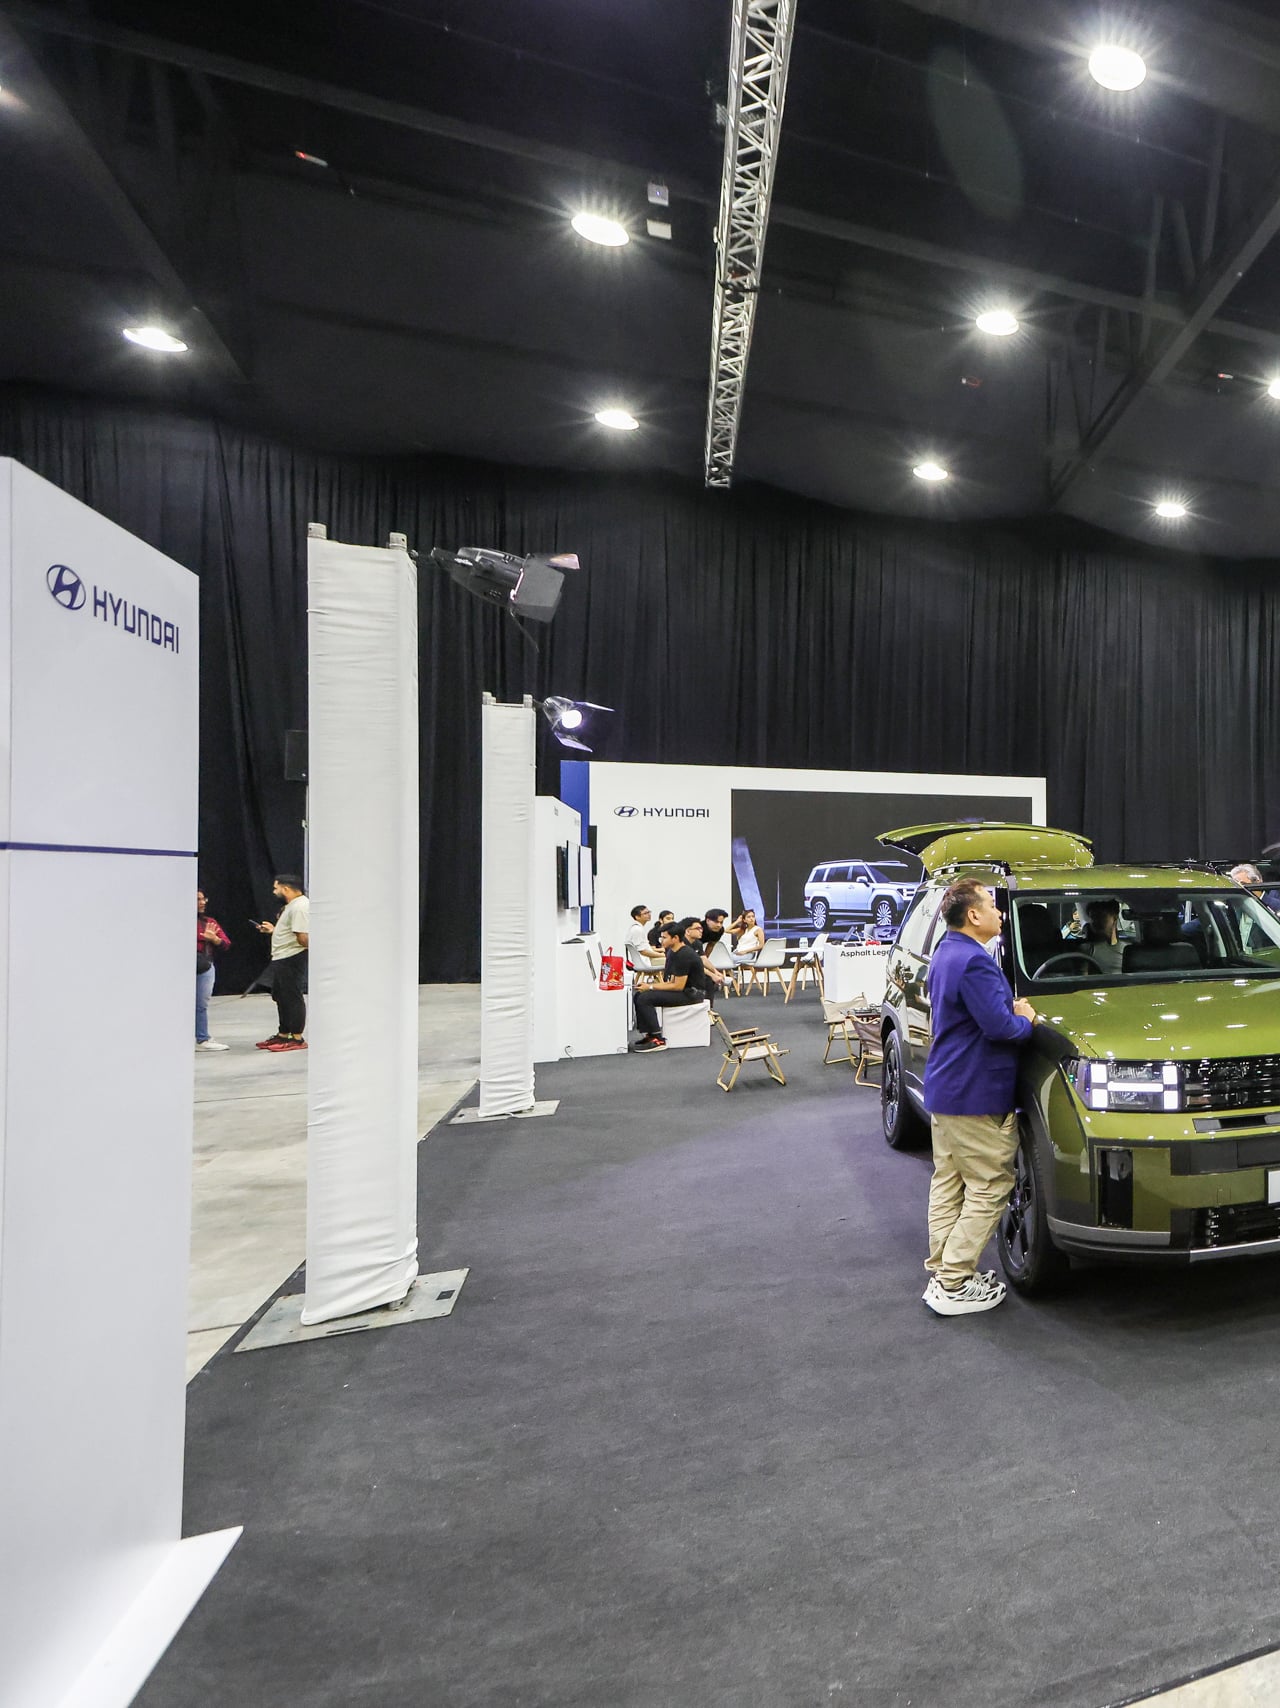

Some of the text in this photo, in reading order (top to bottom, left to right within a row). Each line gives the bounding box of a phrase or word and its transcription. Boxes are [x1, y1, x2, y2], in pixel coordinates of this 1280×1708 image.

[93, 585, 179, 654] HYUNDAI
[643, 807, 710, 818] HYUNDAI
[840, 949, 871, 958] Asphalt
